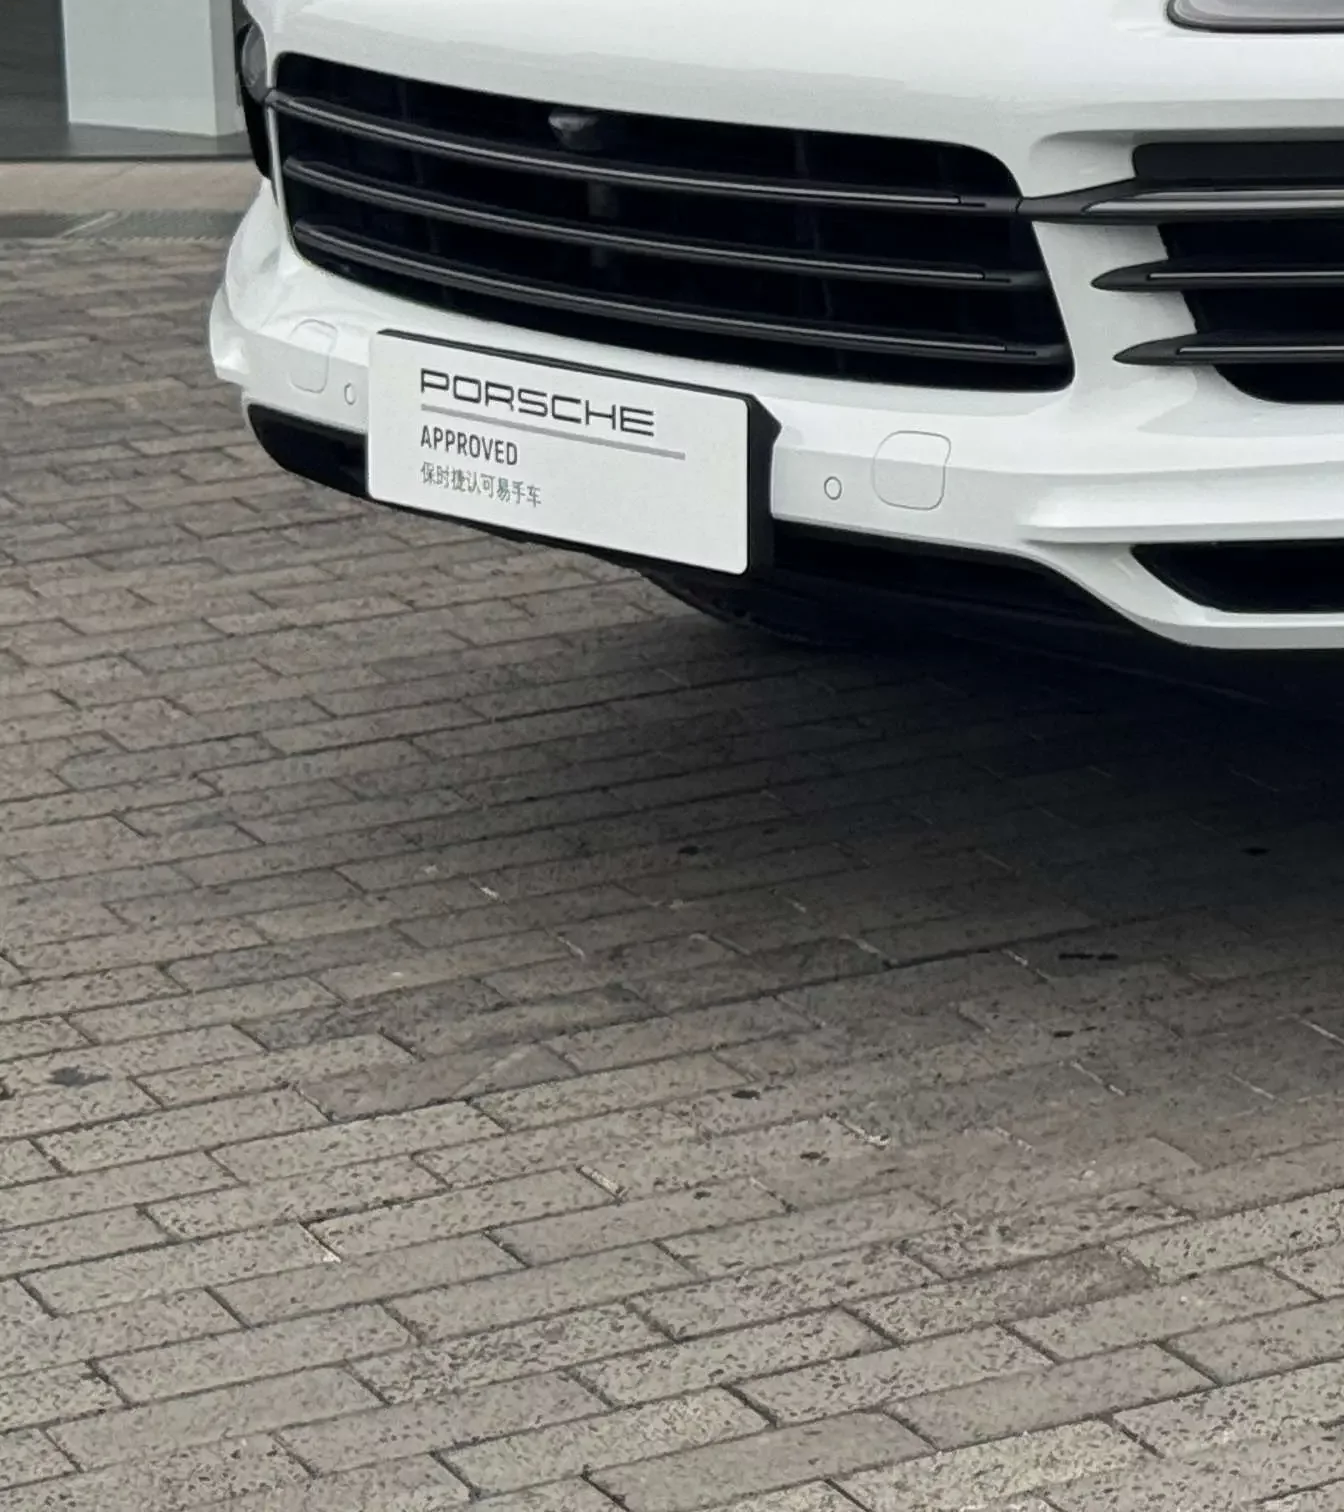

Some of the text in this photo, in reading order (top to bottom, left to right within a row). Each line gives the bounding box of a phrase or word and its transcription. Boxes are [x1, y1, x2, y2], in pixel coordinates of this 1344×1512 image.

[420, 367, 654, 437] PORSCHE
[420, 424, 518, 466] APPROVED
[420, 461, 542, 508] 保时捷认可易手车
